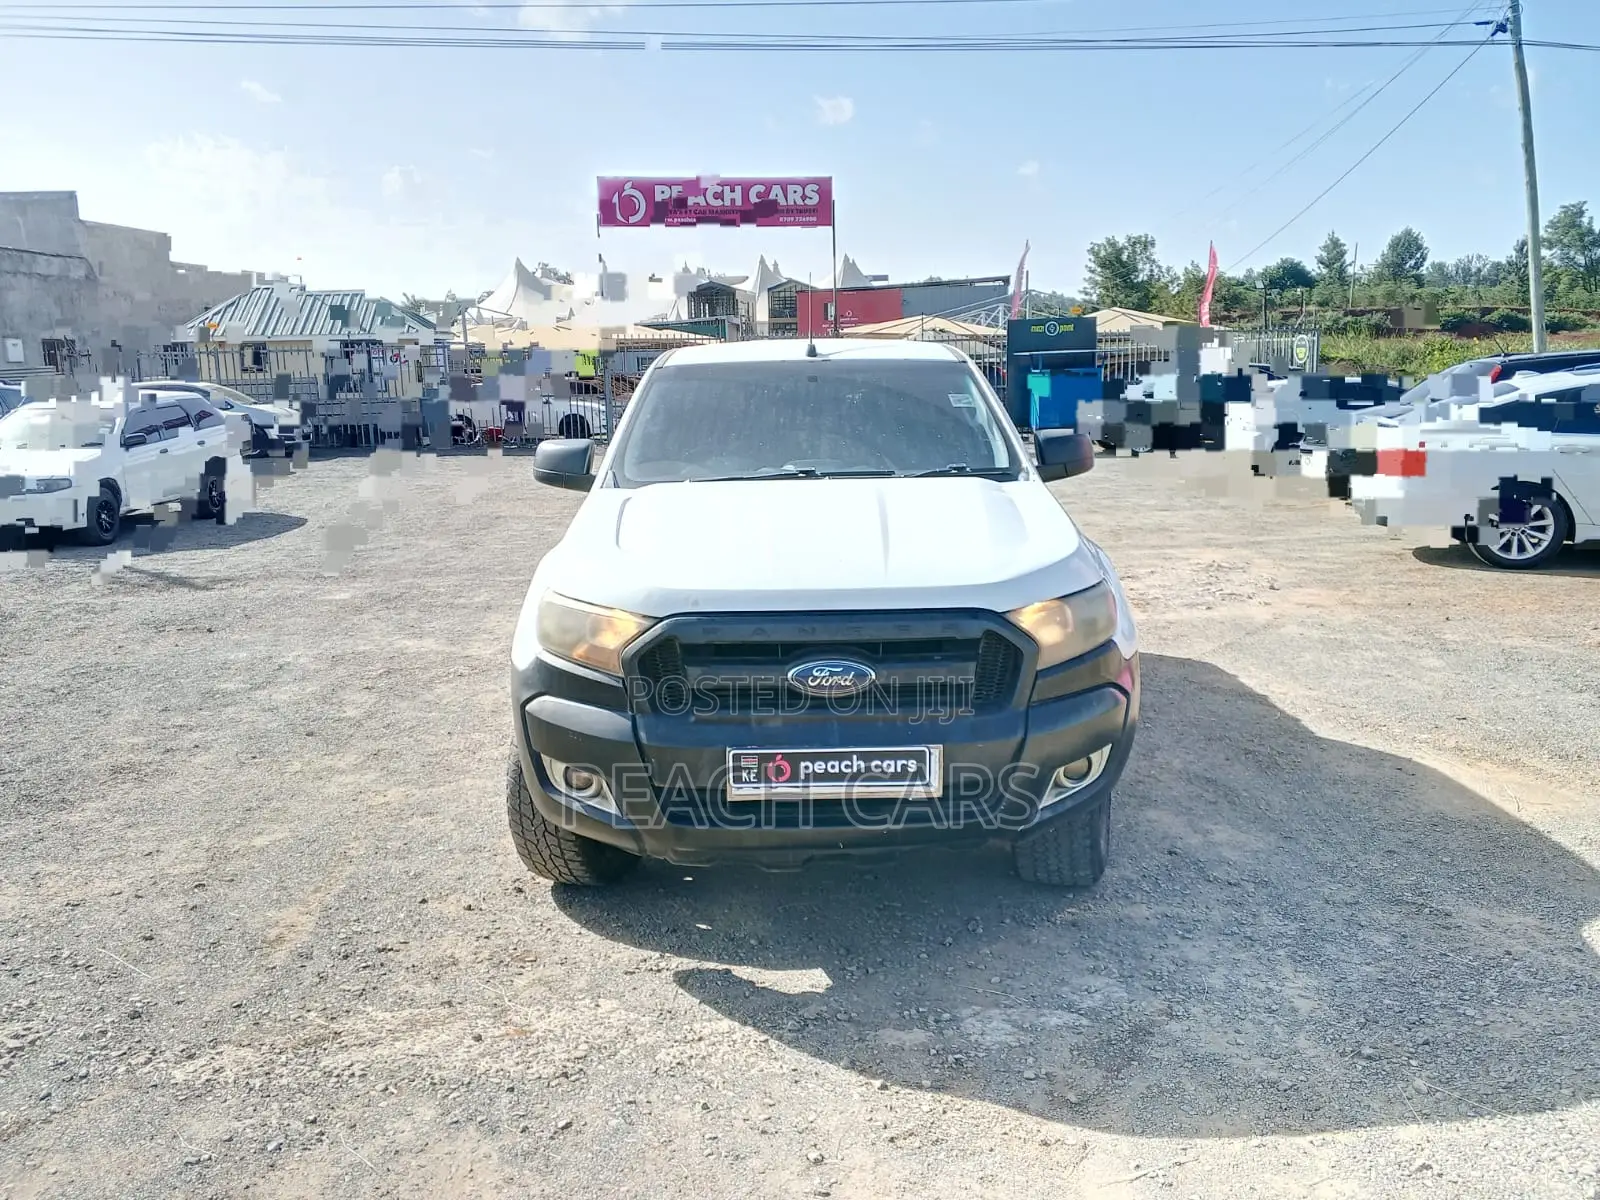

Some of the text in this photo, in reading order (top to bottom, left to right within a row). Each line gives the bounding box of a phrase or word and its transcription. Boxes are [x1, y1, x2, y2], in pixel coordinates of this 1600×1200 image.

[748, 184, 820, 206] CARS
[808, 666, 855, 686] Ford
[742, 769, 758, 783] KE
[800, 754, 918, 780] peach cars
